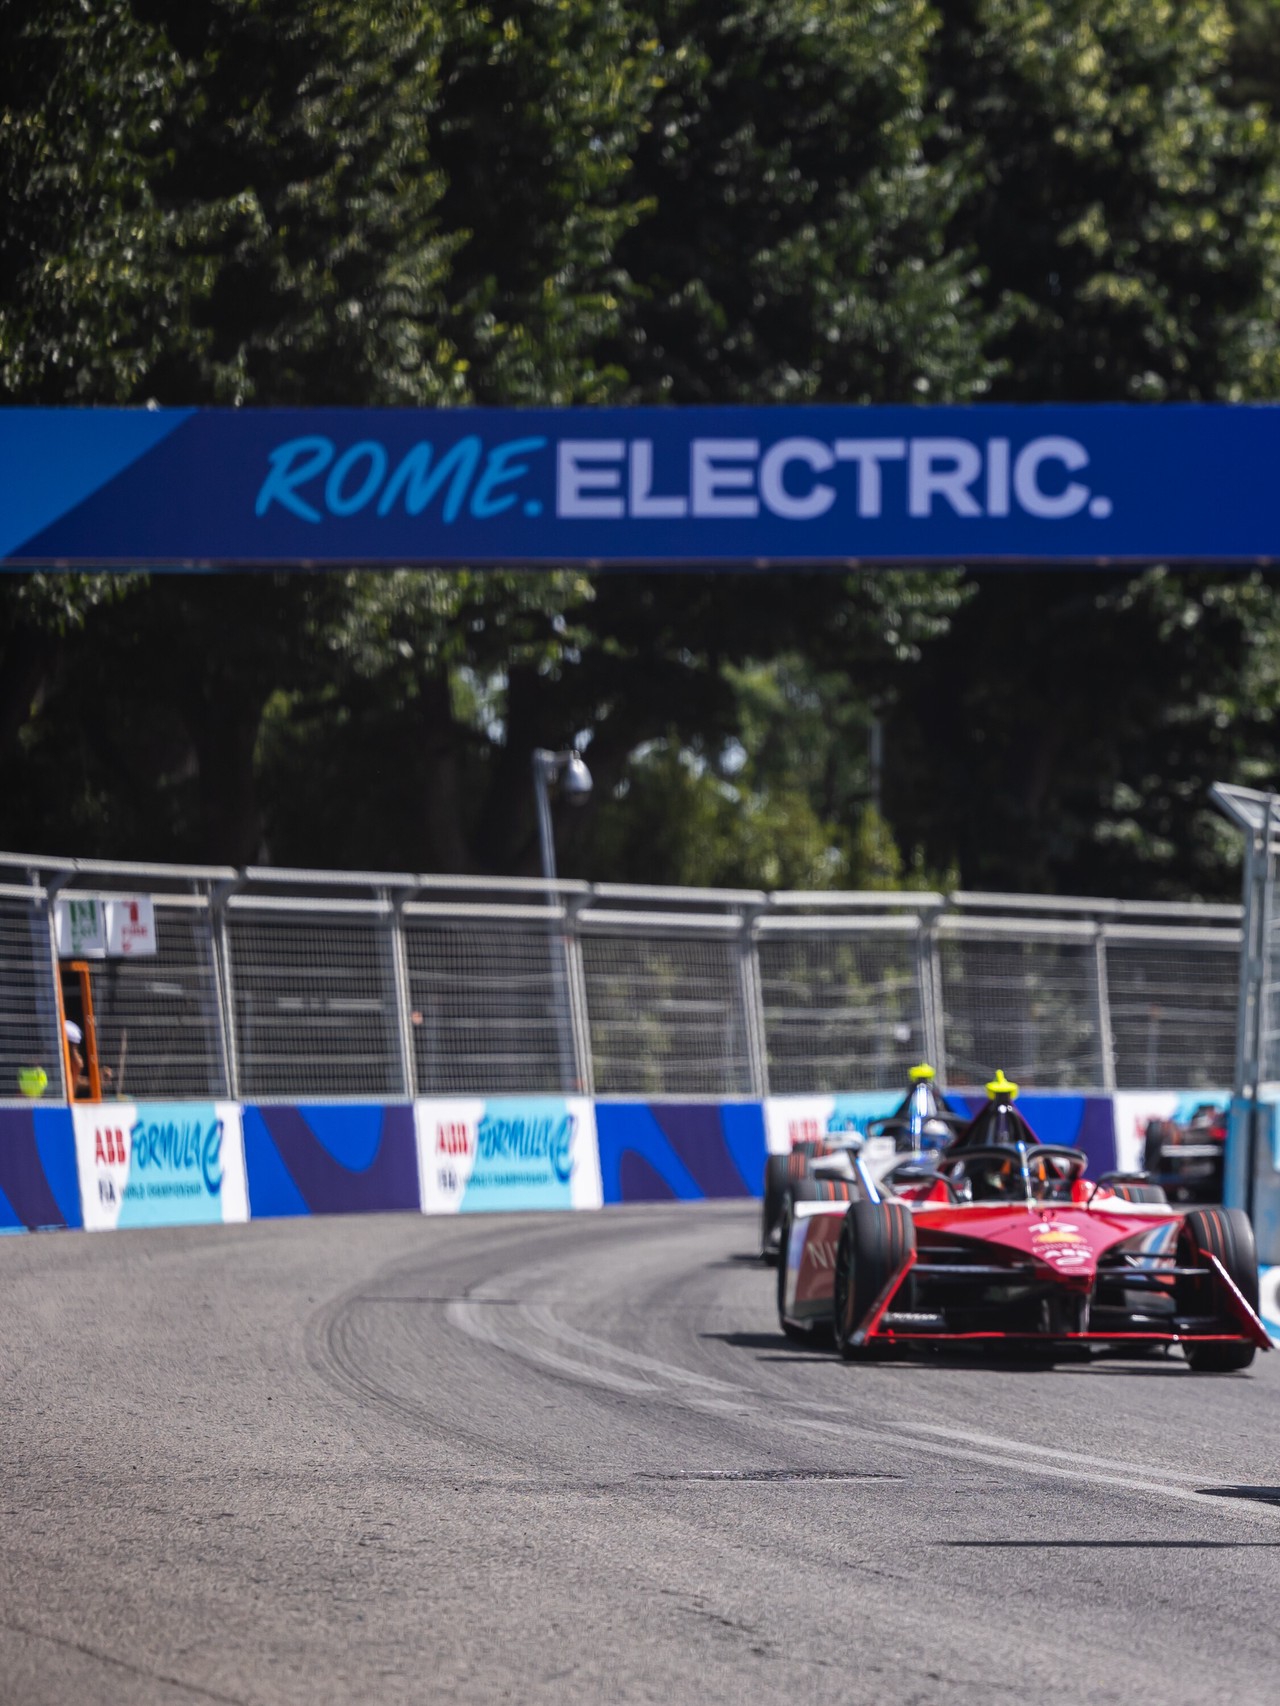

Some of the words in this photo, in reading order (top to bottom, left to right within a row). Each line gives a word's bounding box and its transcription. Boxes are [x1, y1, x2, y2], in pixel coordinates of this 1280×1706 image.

[255, 435, 547, 524] ROME.
[556, 436, 1112, 520] ELECTRIC.
[95, 1126, 126, 1165] ABB
[131, 1119, 201, 1171] FORMULA
